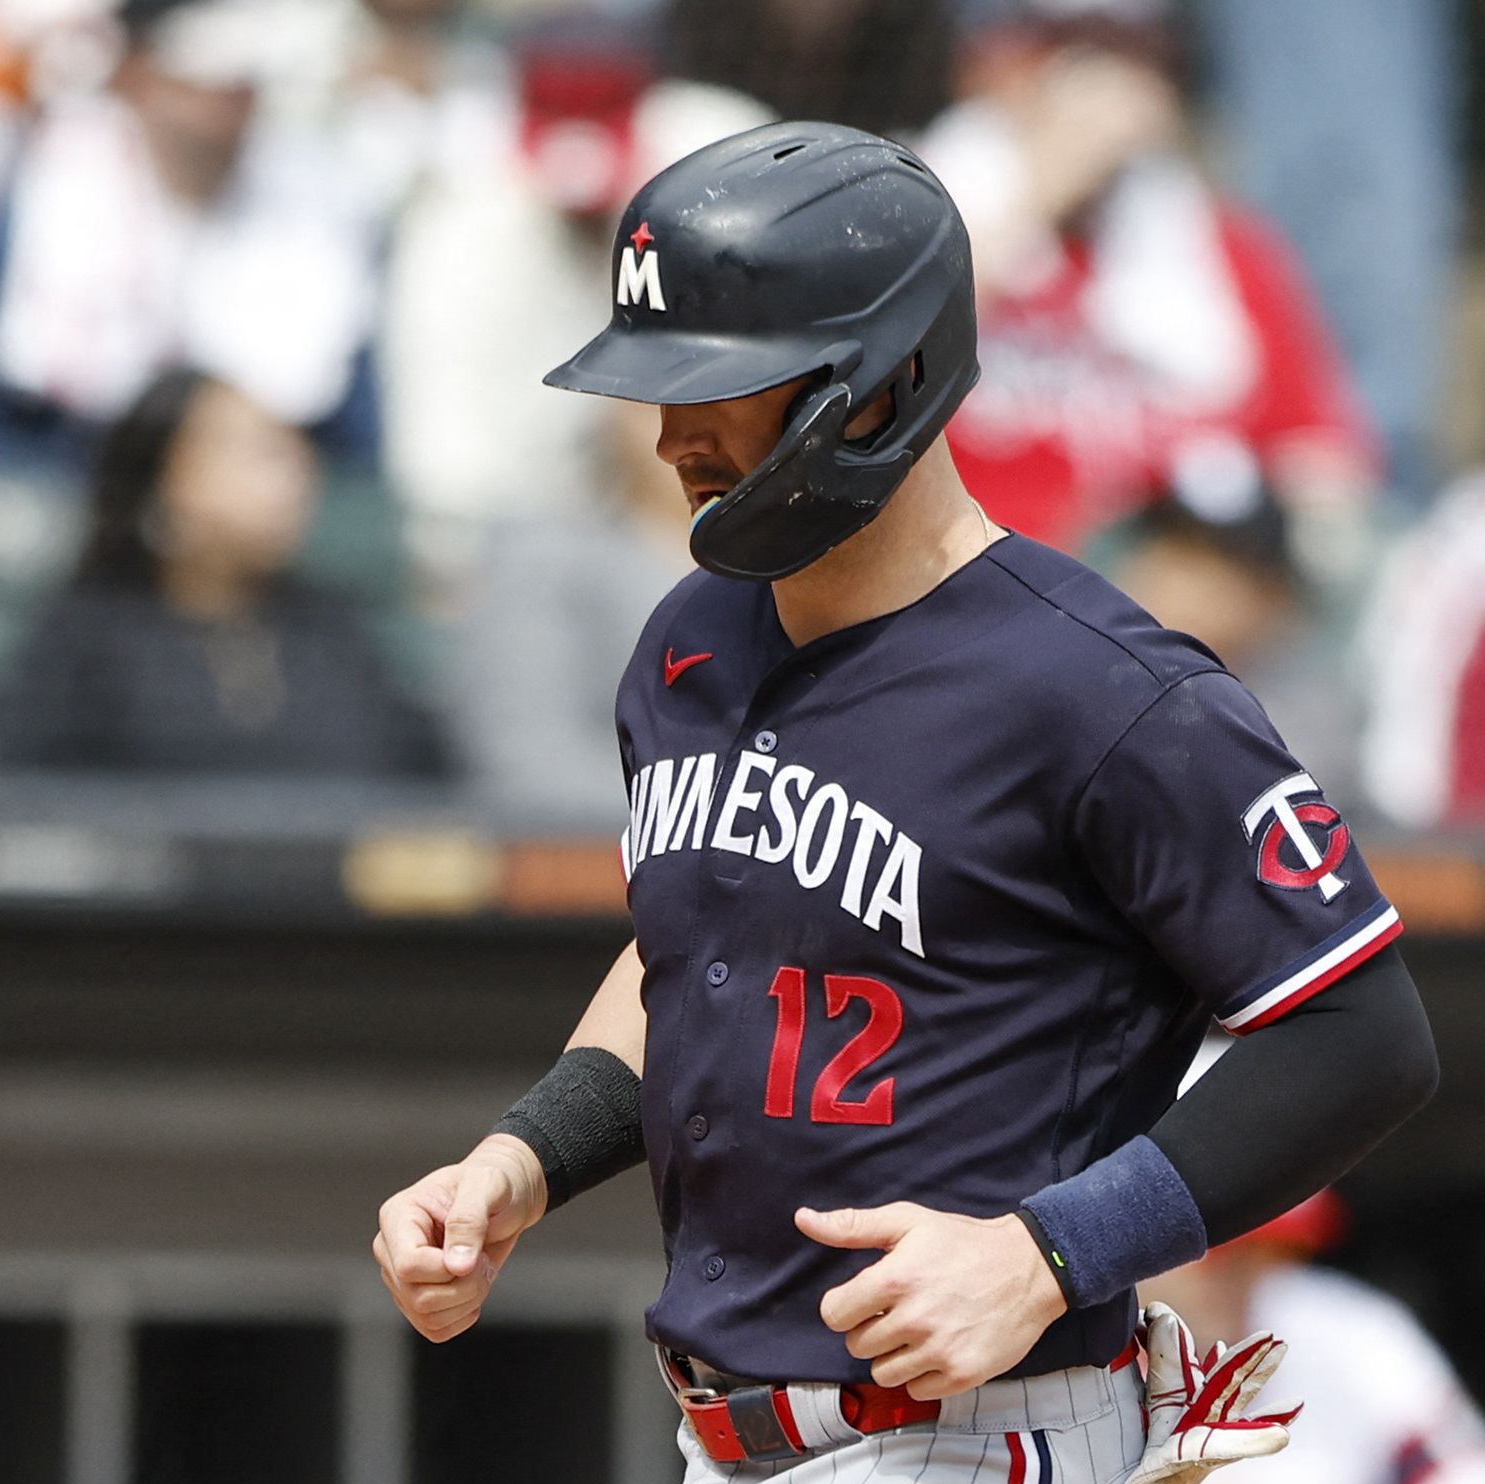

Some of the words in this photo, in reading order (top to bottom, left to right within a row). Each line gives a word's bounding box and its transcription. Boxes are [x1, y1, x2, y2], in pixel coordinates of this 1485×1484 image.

[617, 246, 666, 311] M
[630, 750, 926, 958] INNESOTA
[764, 966, 904, 1126] 12
